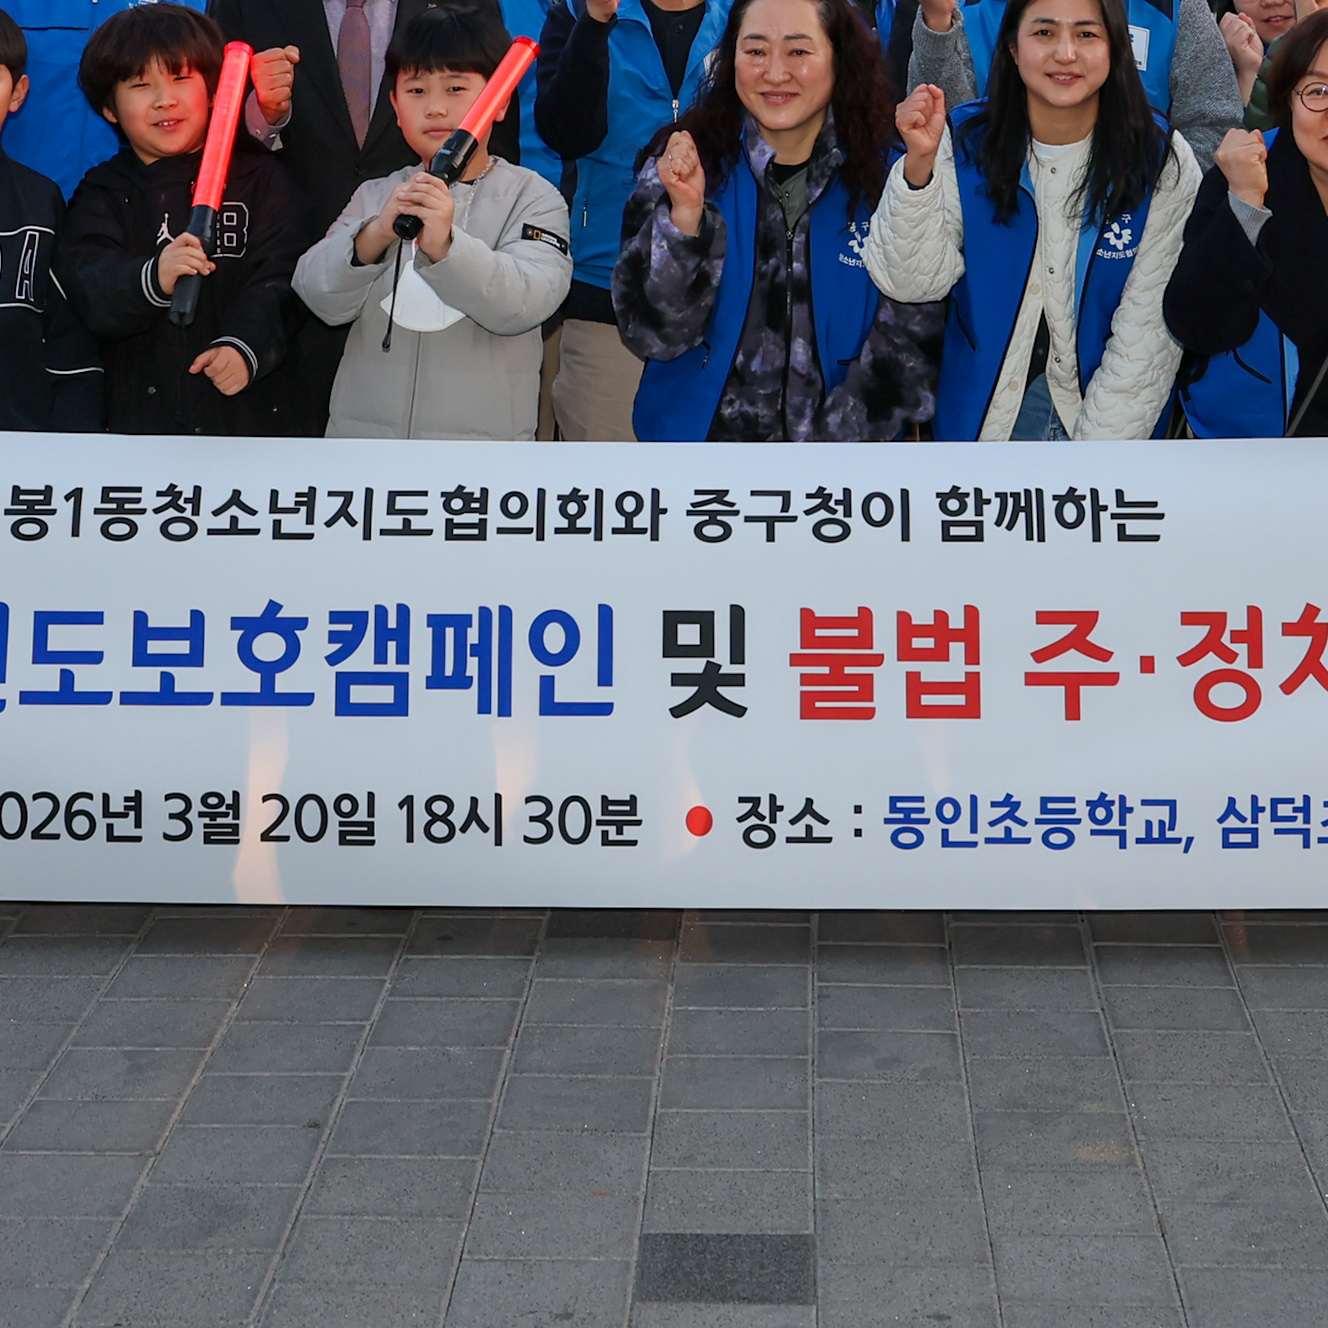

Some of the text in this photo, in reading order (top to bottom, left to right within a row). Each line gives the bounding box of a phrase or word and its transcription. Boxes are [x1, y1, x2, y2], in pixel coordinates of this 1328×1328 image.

[686, 486, 910, 543] 중구청이
[936, 485, 1165, 542] 함께하는
[662, 604, 749, 720] 및
[789, 605, 981, 721] 불법
[163, 790, 240, 845] 3월
[260, 791, 377, 846] 20일
[398, 793, 503, 847] 18시
[523, 794, 644, 847] 30분
[736, 793, 833, 849] 장소
[884, 792, 1194, 854] 동인초등학교,
